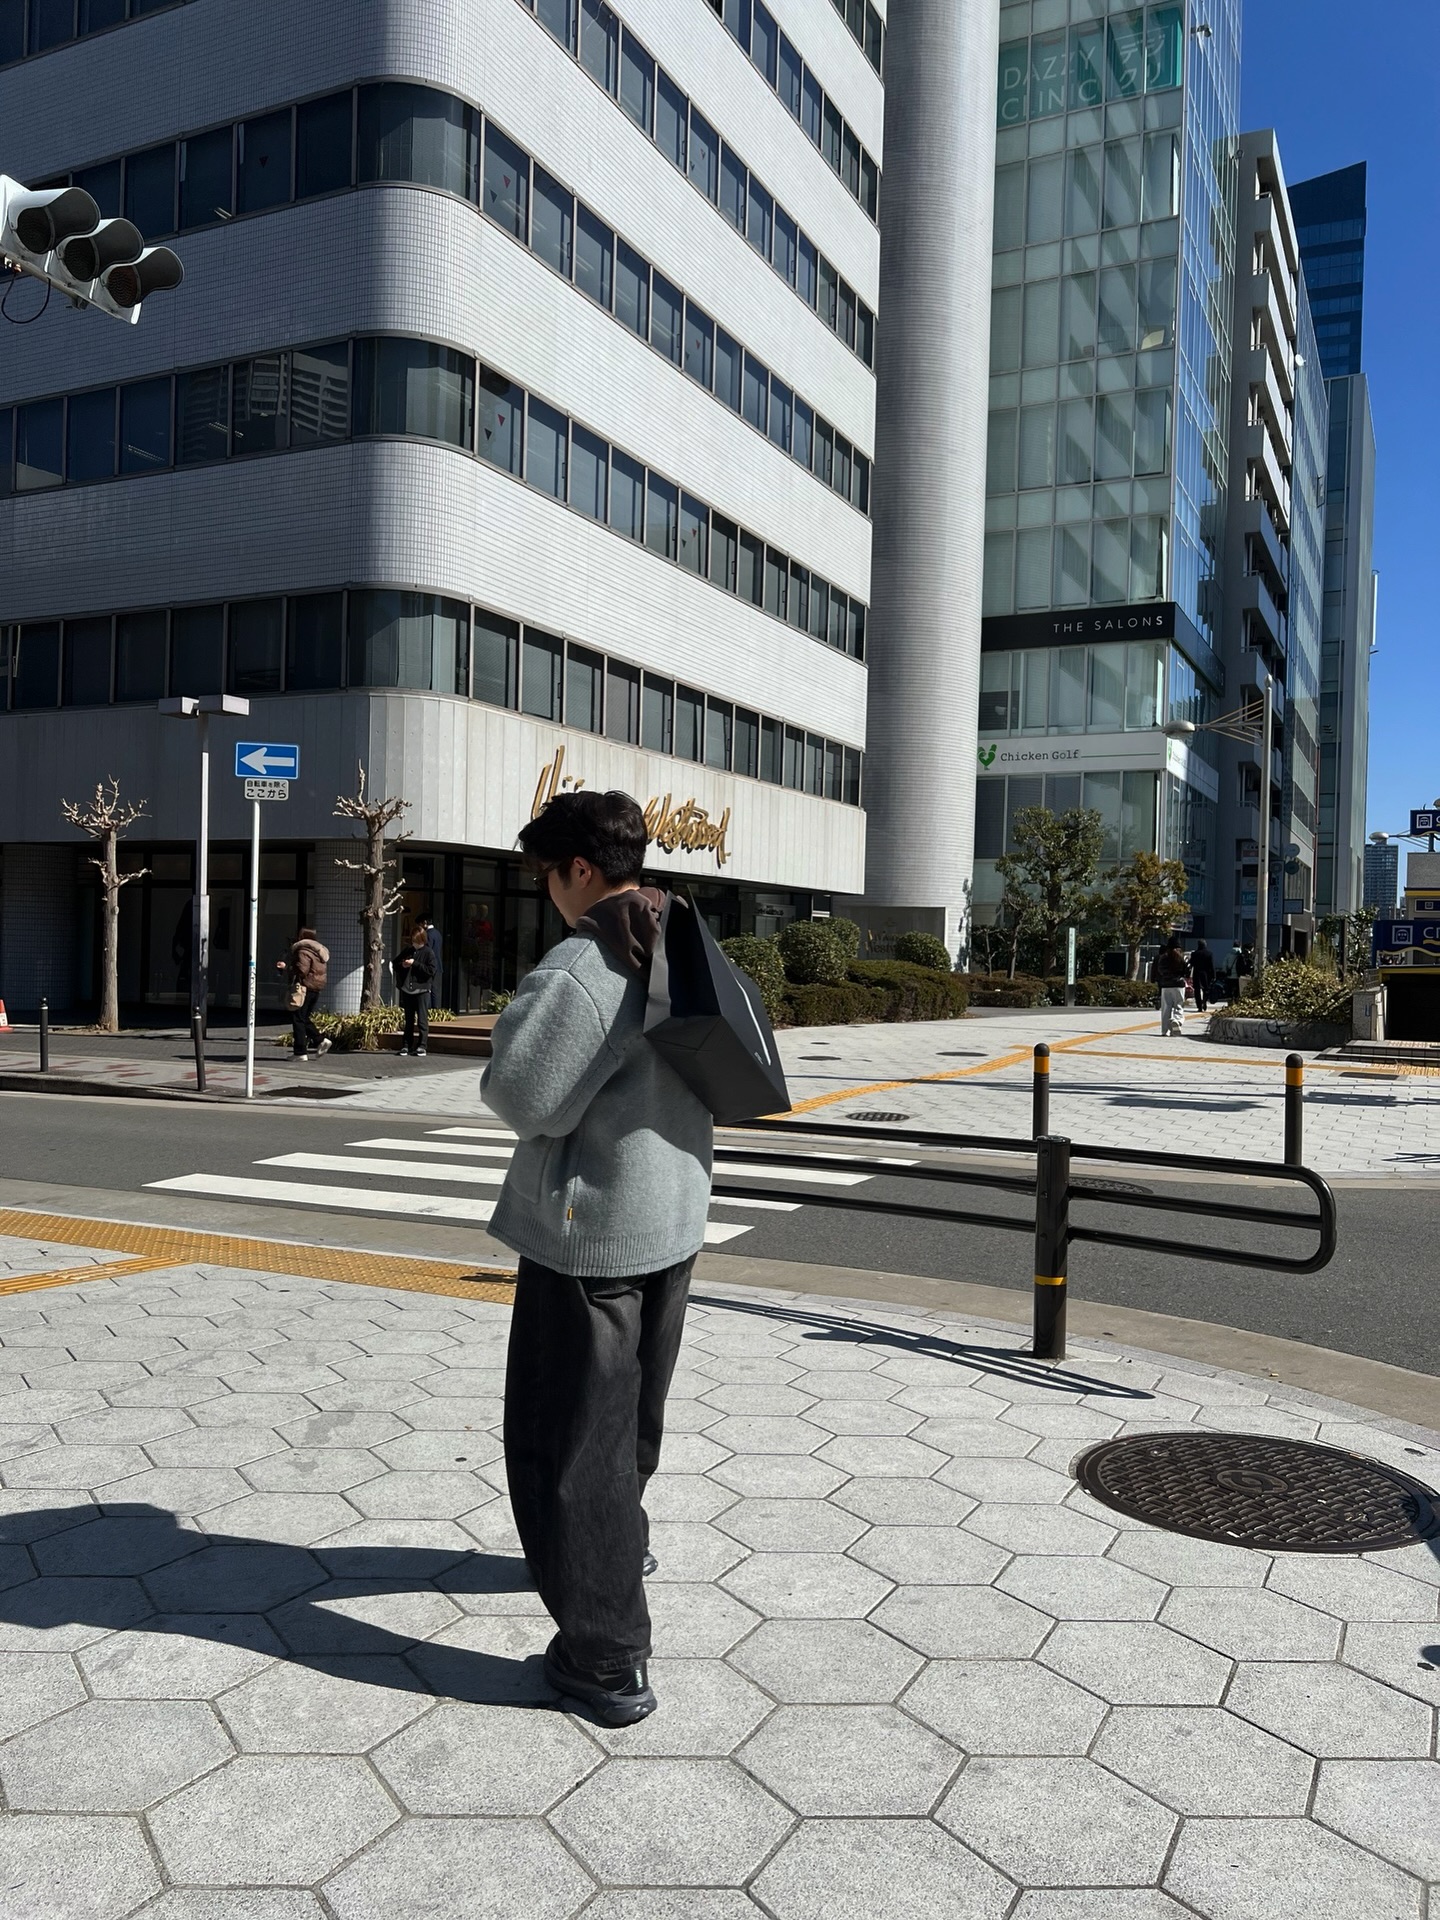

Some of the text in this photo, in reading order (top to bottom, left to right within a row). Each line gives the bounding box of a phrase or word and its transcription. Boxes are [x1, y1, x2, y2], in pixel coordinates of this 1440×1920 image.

[1004, 46, 1096, 90] DAZZY
[1119, 62, 1161, 90] クリ
[1001, 79, 1097, 120] CLINIC
[1053, 616, 1163, 634] THE SALONS
[1000, 749, 1080, 762] Chicken Golf
[246, 780, 286, 788] 自転車を除く
[246, 788, 287, 799] ここから
